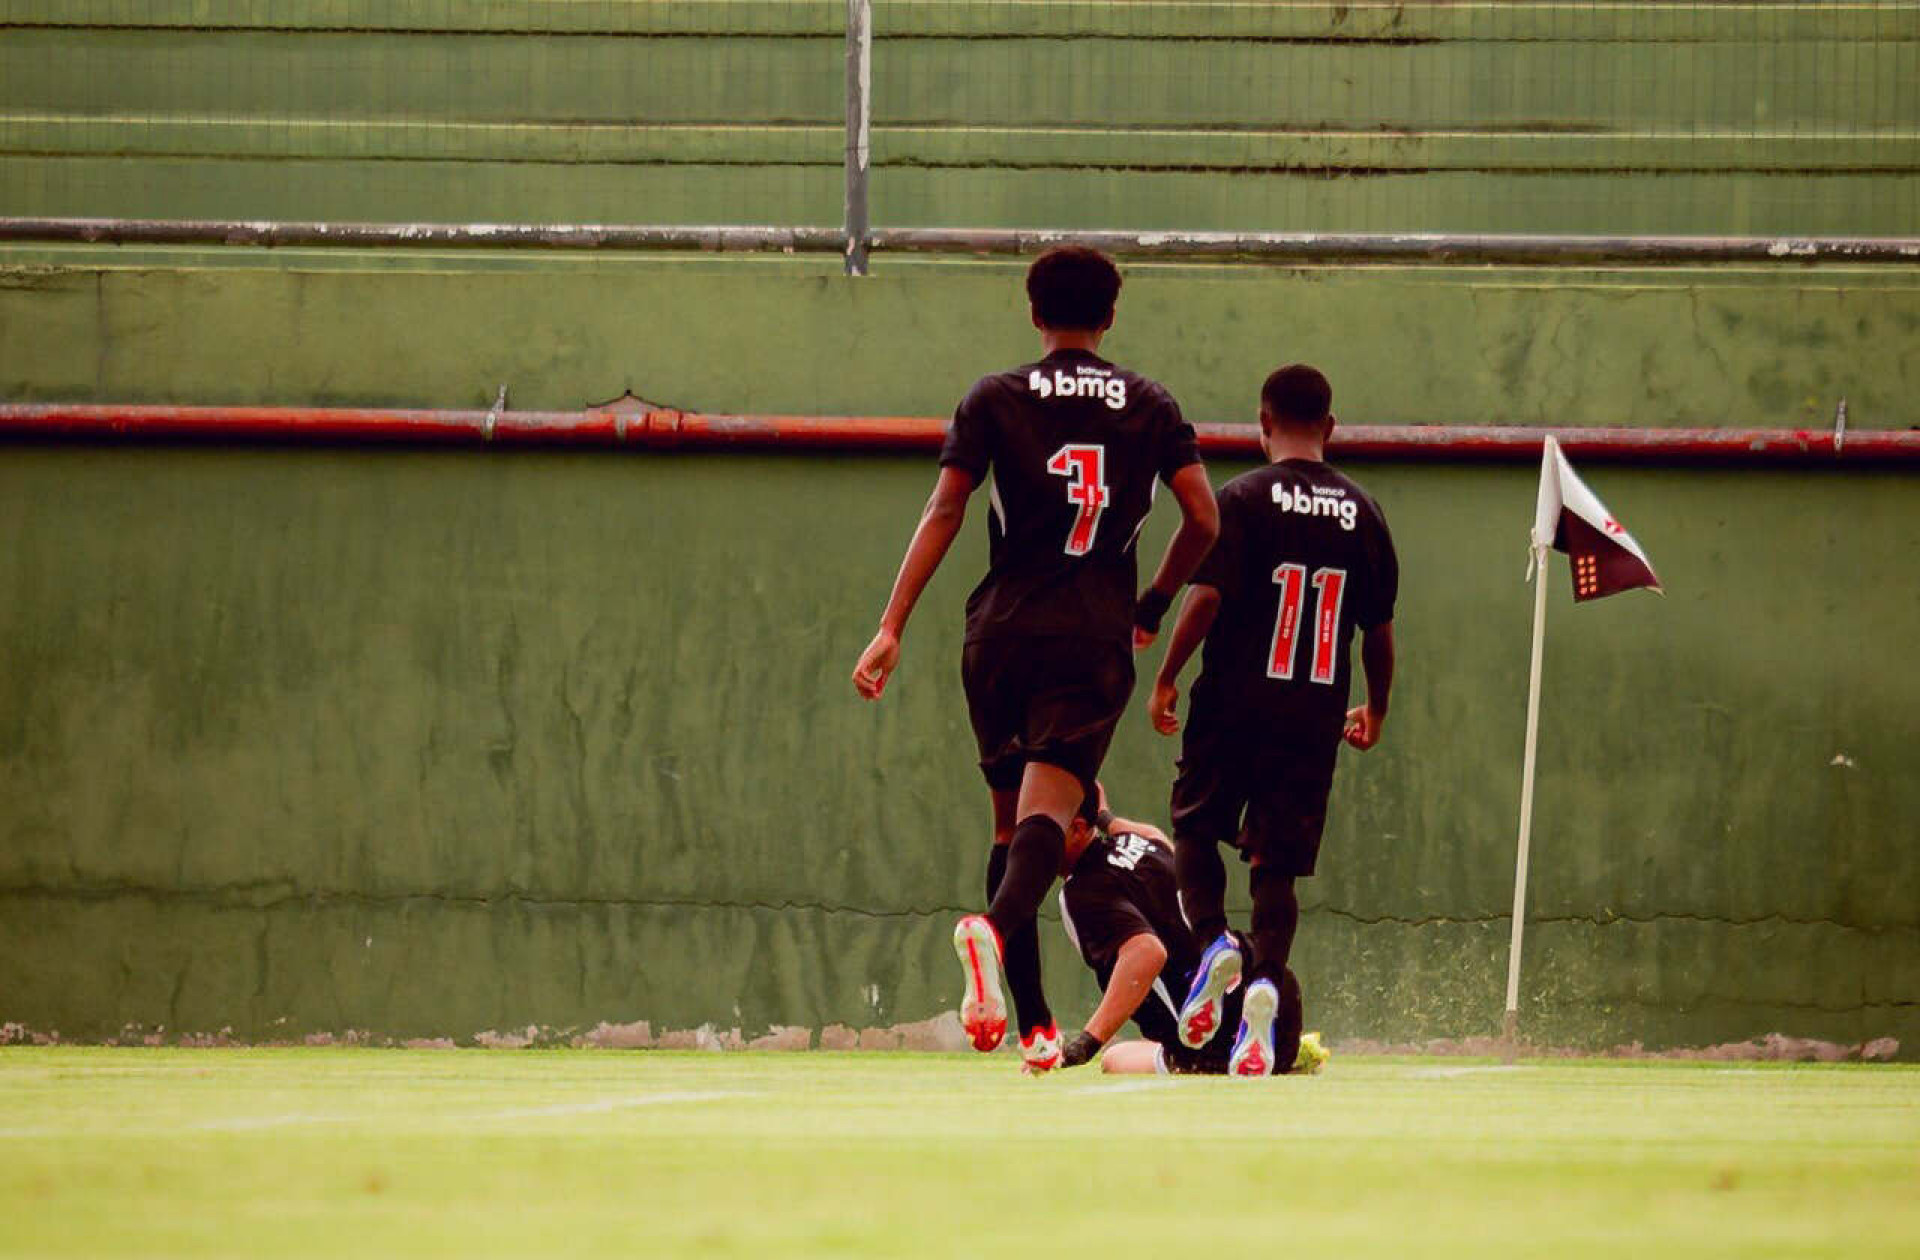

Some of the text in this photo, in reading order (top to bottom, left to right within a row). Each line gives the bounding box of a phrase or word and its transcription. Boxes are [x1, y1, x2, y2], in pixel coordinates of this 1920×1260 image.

[1055, 369, 1126, 410] bmg
[1046, 443, 1110, 556] 7
[1293, 485, 1357, 531] bmg
[1266, 562, 1347, 685] 11
